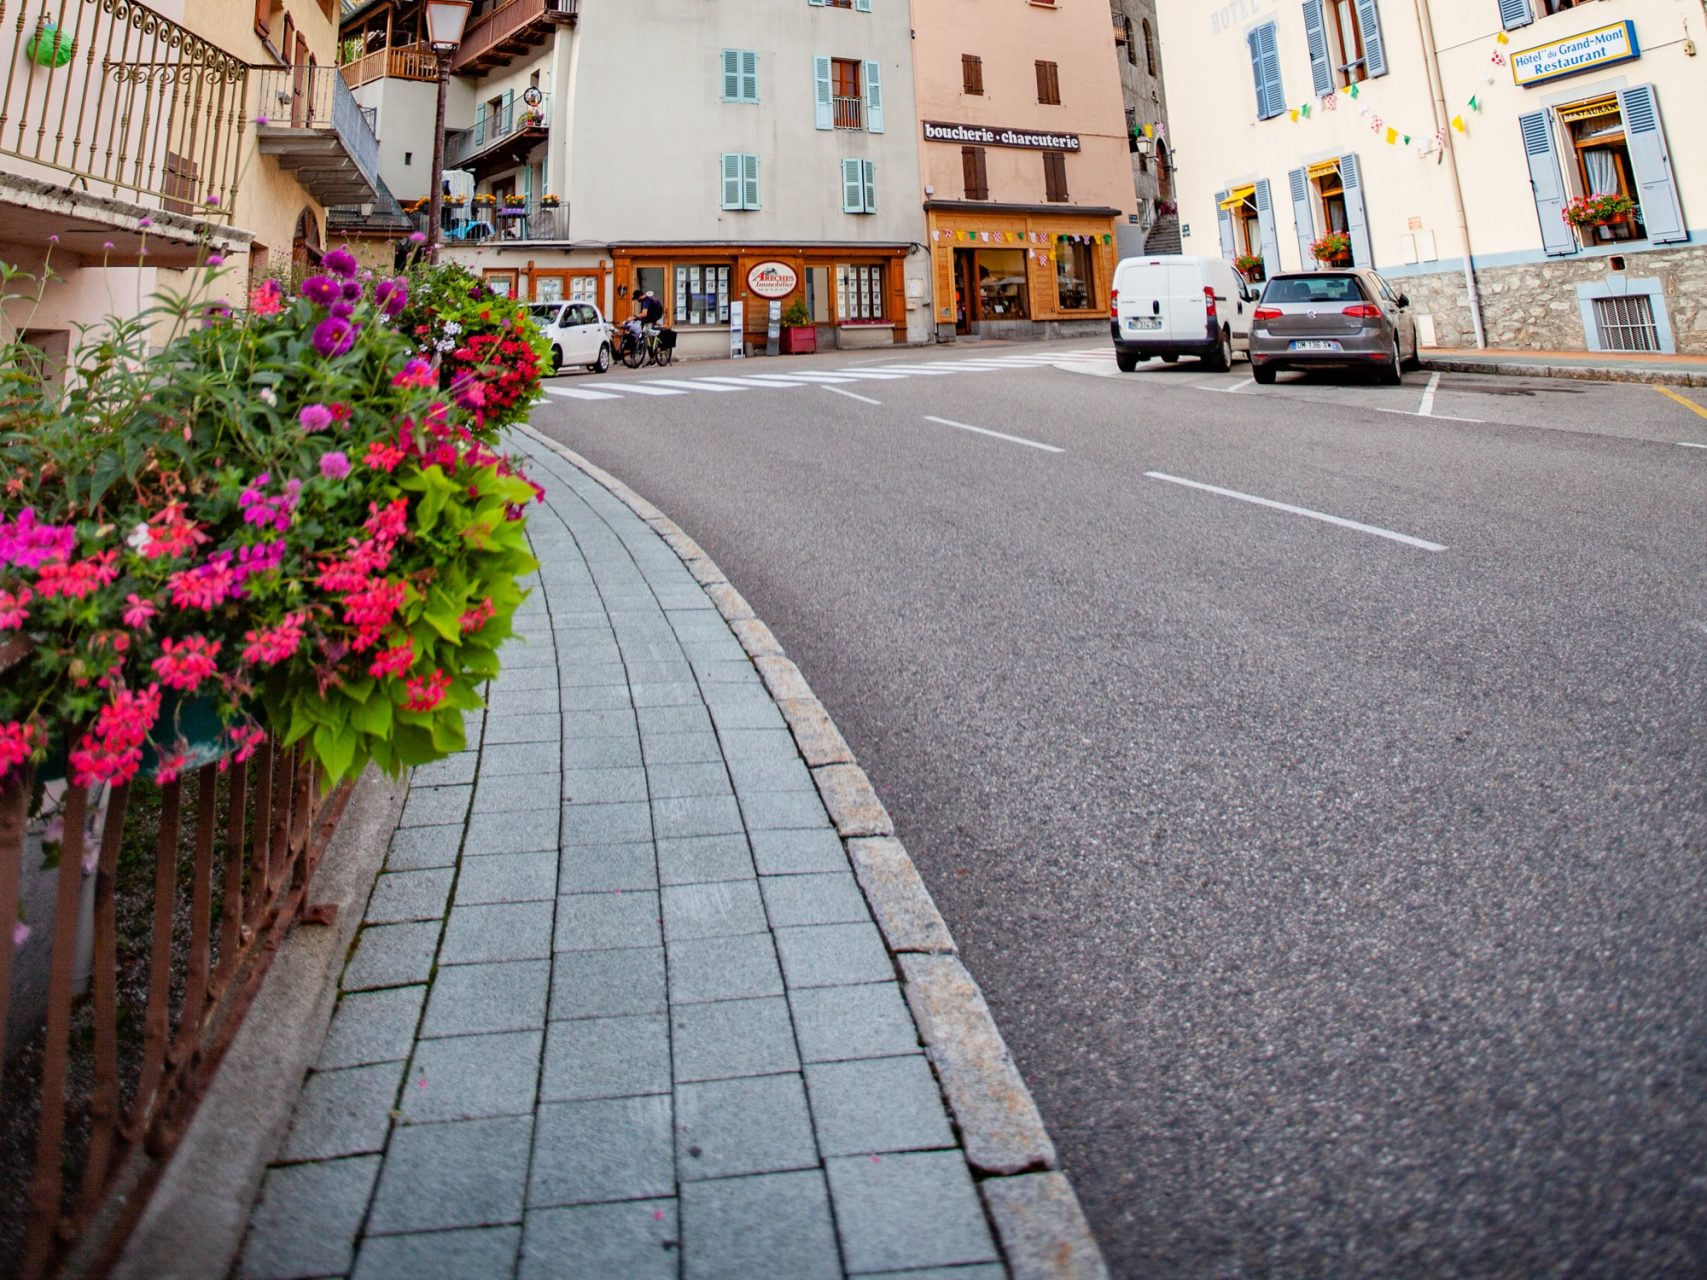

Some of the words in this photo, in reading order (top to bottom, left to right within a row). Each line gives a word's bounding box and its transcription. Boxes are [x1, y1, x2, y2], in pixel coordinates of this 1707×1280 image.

[1515, 50, 1542, 67] Hôtel
[1547, 50, 1557, 59] du
[1558, 28, 1624, 55] Grand-Mont
[1534, 47, 1608, 75] Restaurant
[1564, 103, 1617, 121] RESTAURAN
[925, 124, 994, 142] boucherie
[1001, 131, 1079, 149] charcuterie
